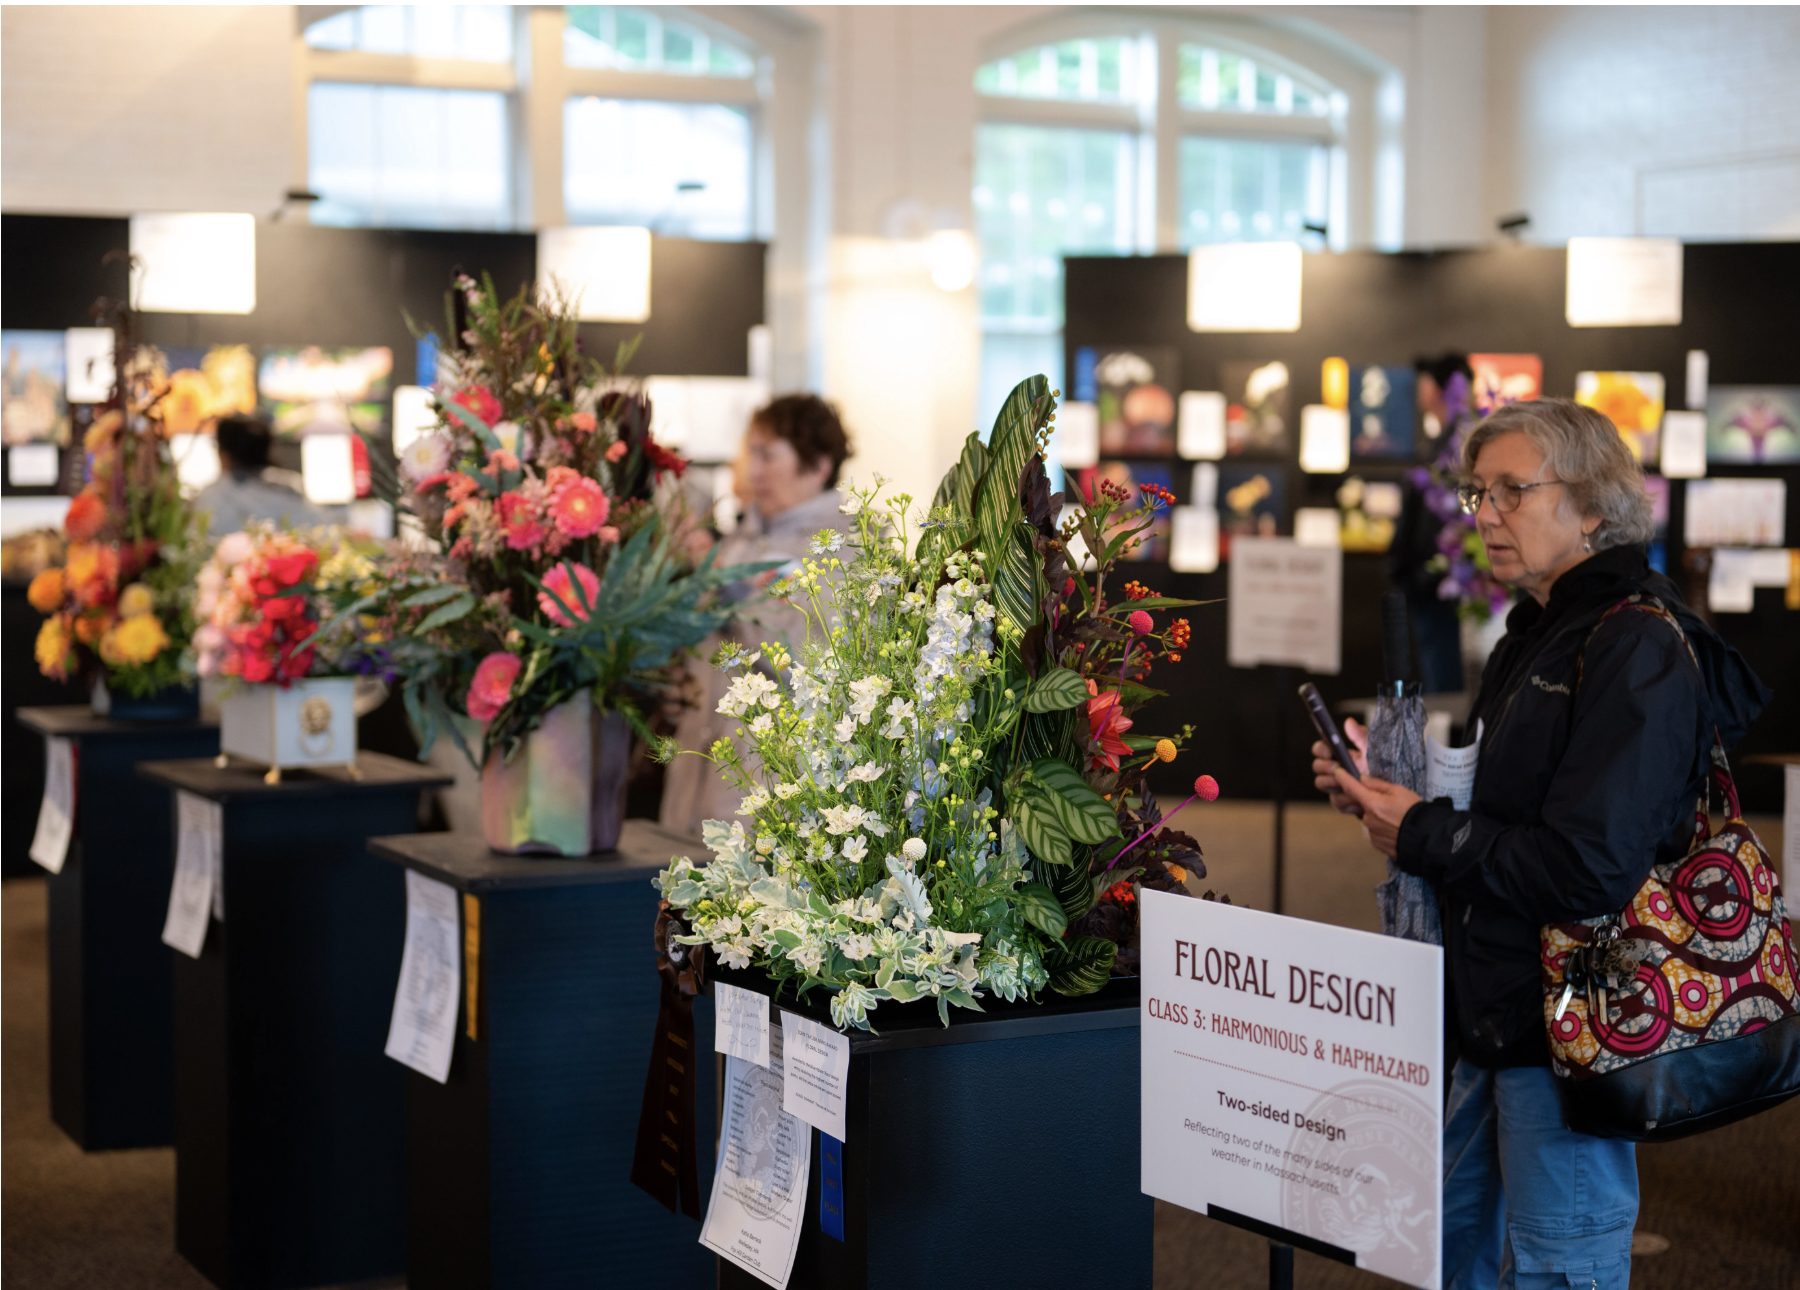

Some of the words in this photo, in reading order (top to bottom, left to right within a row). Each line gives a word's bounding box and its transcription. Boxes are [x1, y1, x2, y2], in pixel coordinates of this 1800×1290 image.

[1174, 939, 1276, 999] FLORAL
[1288, 964, 1396, 1027] DESIGN
[1148, 997, 1189, 1025] CLASS
[1193, 1009, 1206, 1030] 3:
[1211, 1013, 1308, 1056] HARMONIOUS
[1313, 1039, 1325, 1061] &
[1332, 1043, 1430, 1087] HAPHAZARD
[1217, 1090, 1290, 1125] Two-sided
[1294, 1112, 1346, 1142] Design
[1183, 1118, 1231, 1144] Reflecting
[1232, 1133, 1251, 1148] two
[1252, 1140, 1263, 1151] of
[1264, 1143, 1281, 1157] the
[1283, 1150, 1313, 1170] many
[1314, 1157, 1341, 1176] sides
[1342, 1166, 1355, 1178] of
[1355, 1171, 1374, 1185] our
[1211, 1147, 1251, 1167] weather
[1252, 1157, 1262, 1171] in
[1264, 1162, 1341, 1196] Massachusetts.
[824, 1201, 839, 1216] PLACE
[825, 1177, 838, 1190] FIRST
